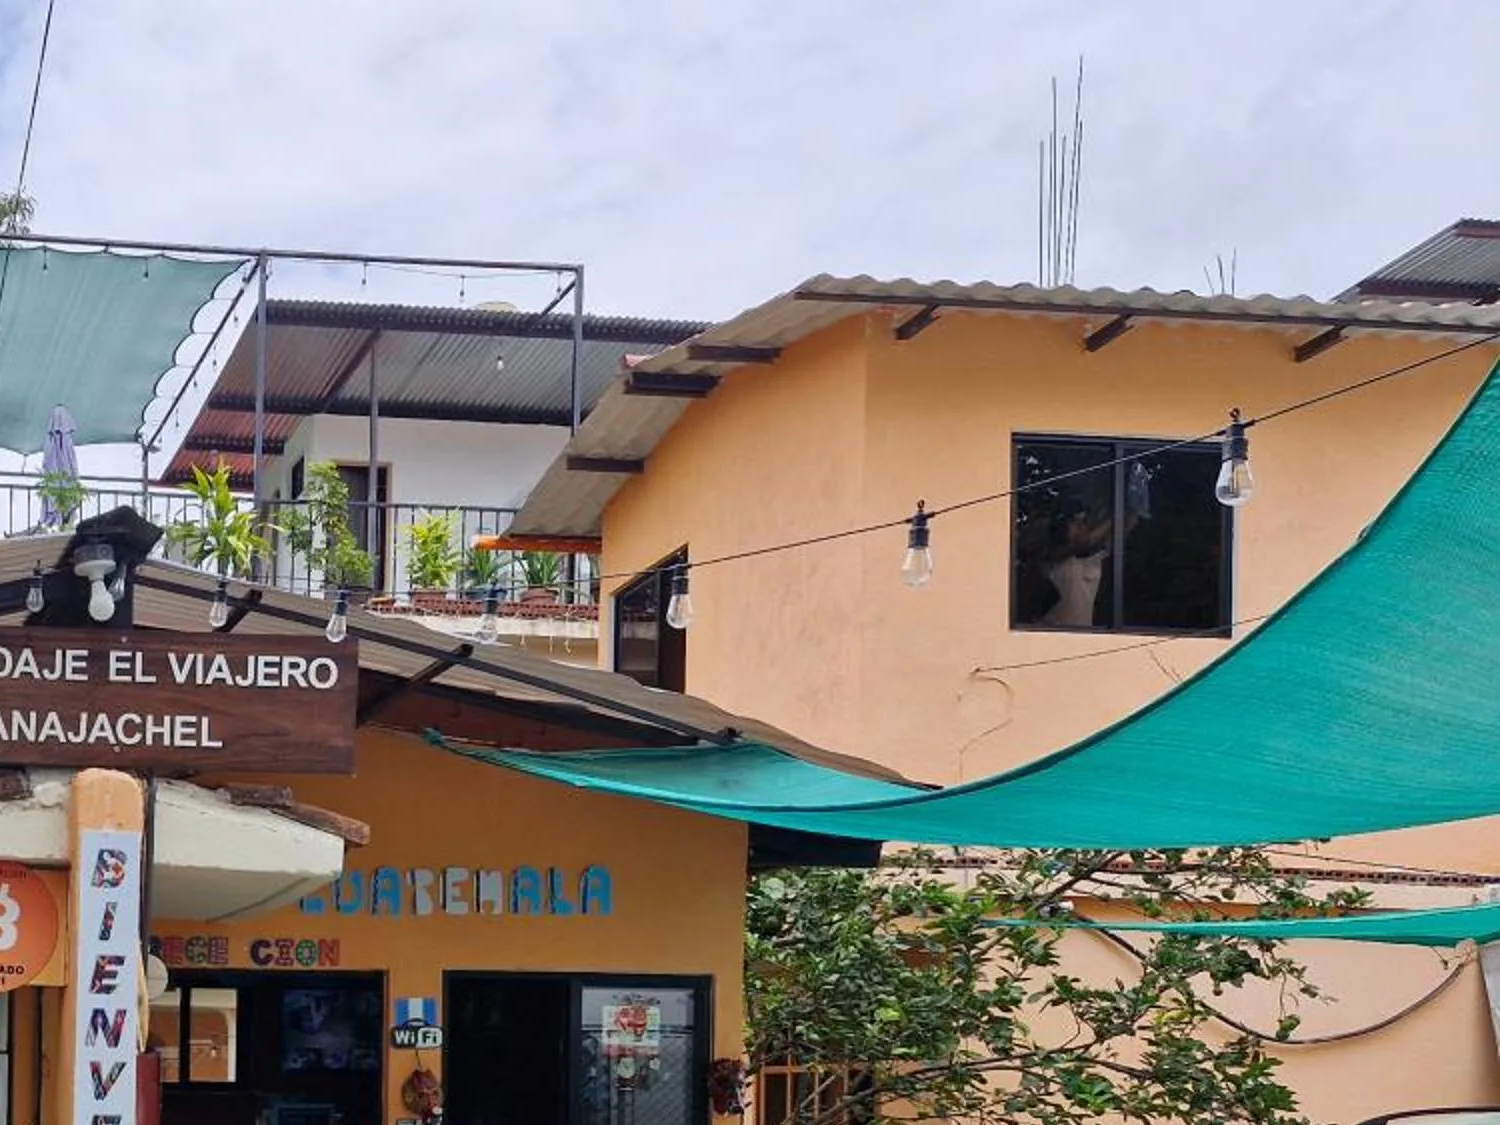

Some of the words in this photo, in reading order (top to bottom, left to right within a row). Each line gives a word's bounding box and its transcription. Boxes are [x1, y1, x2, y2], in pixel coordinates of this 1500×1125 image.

[108, 650, 156, 684] EL
[168, 652, 339, 690] VIAJERO
[250, 939, 341, 967] CION
[395, 1029, 437, 1045] WiFi
